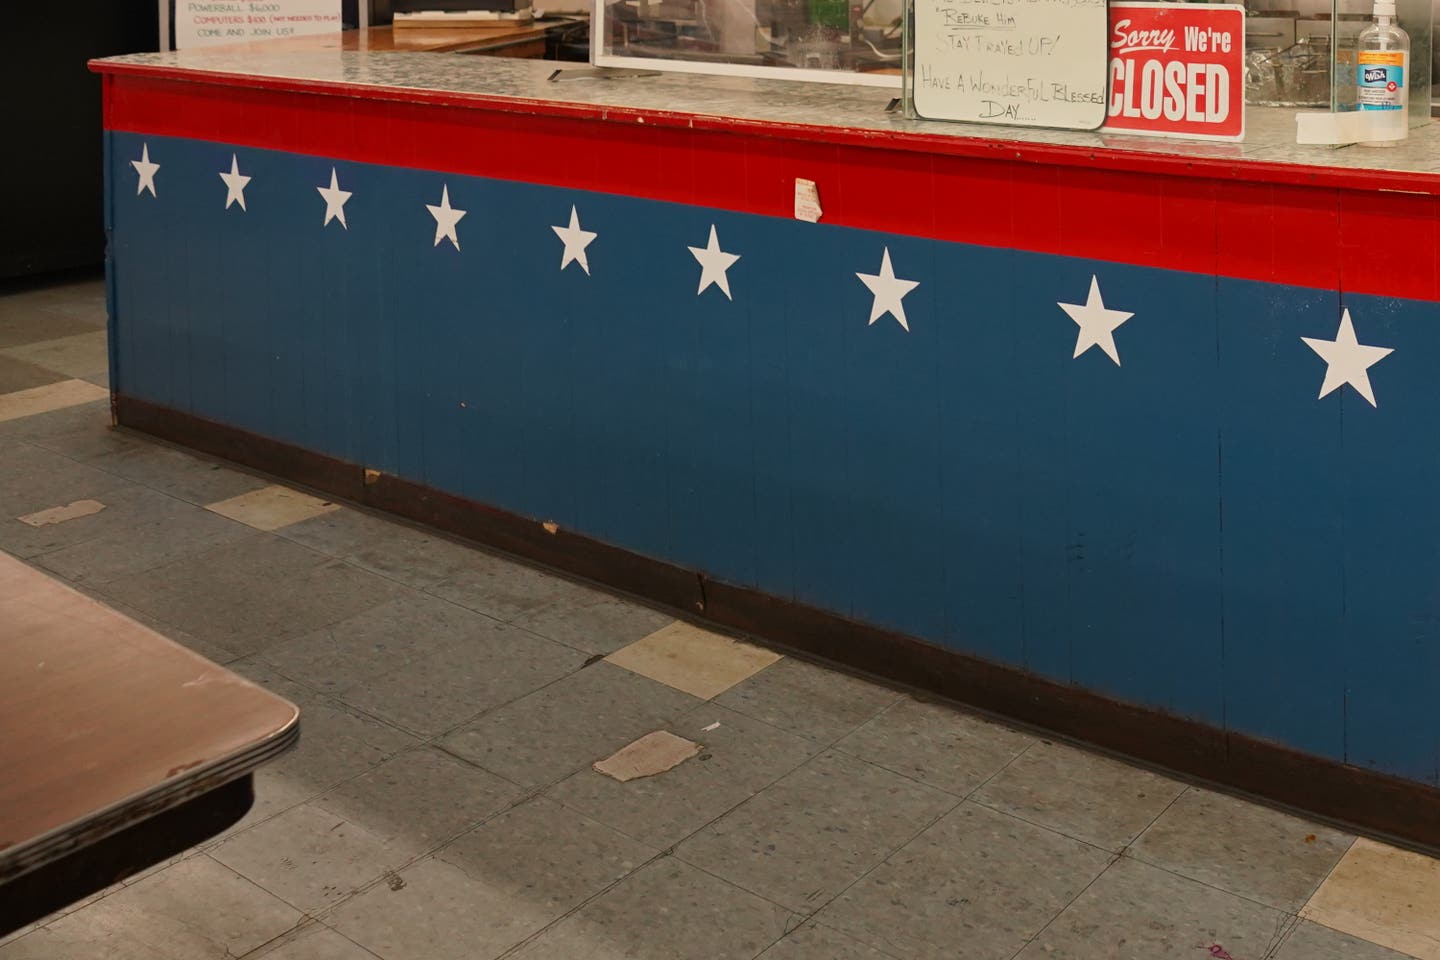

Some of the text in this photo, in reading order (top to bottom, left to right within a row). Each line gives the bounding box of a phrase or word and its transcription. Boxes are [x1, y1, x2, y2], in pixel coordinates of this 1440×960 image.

[1112, 20, 1232, 54] Sorry We're
[1109, 59, 1230, 123] CLOSED
